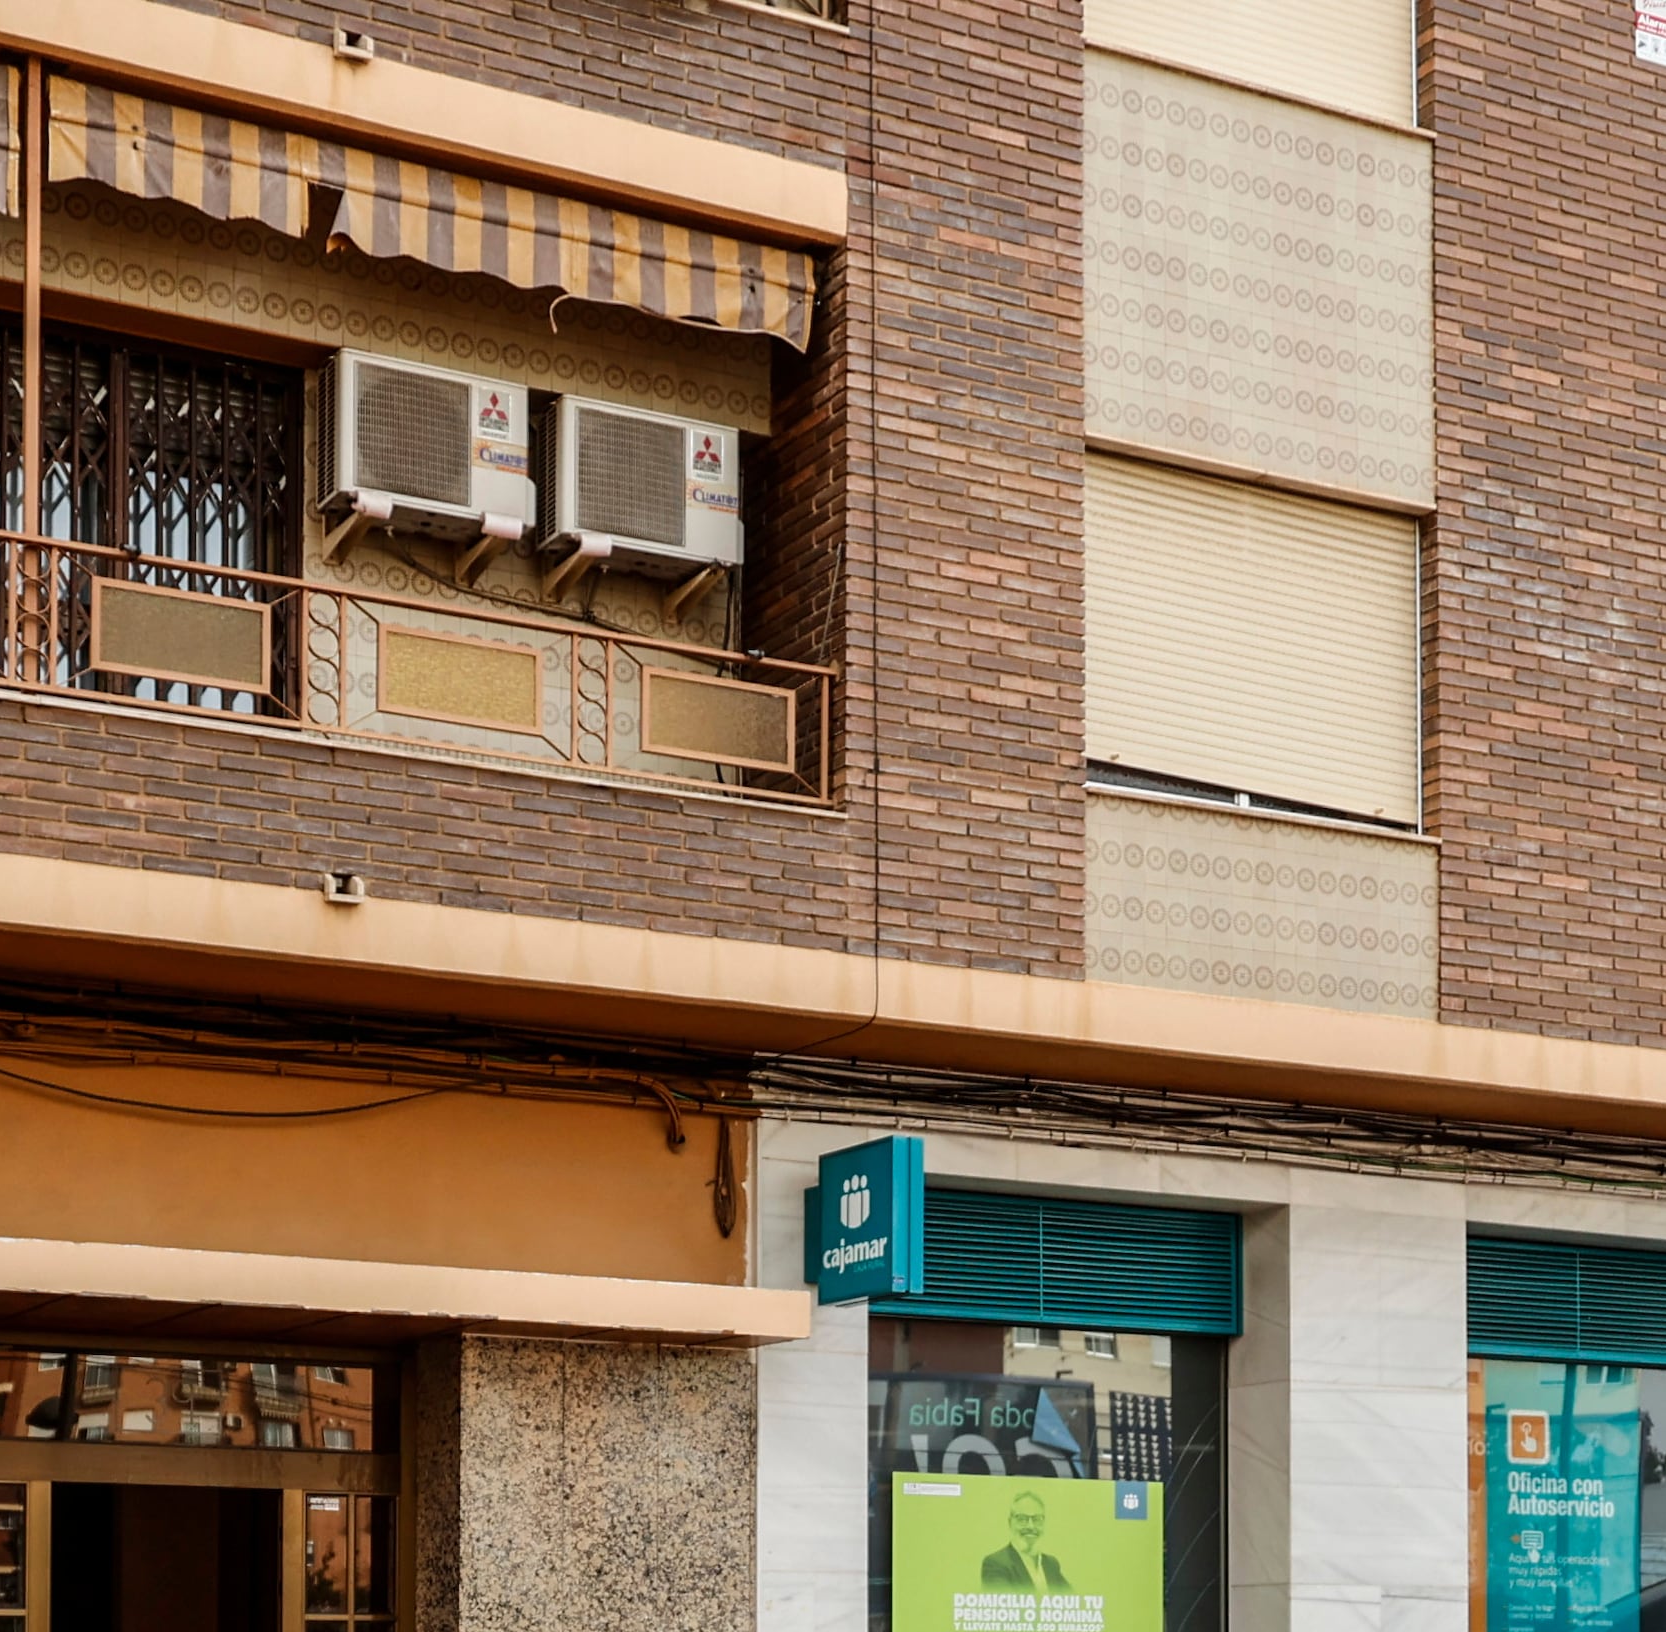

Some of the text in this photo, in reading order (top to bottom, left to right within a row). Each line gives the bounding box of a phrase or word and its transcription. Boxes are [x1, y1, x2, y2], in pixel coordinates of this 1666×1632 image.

[822, 1236, 888, 1275] cajamar
[1507, 1470, 1604, 1496] Oficina con
[1507, 1494, 1615, 1518] Autoservicio
[953, 1592, 1036, 1609] DOMICILIA
[1084, 1594, 1104, 1610] TU
[1024, 1608, 1037, 1622] O
[953, 1621, 961, 1631] Y
[1003, 1622, 1034, 1632] HASTA
[1036, 1623, 1057, 1632] 500
